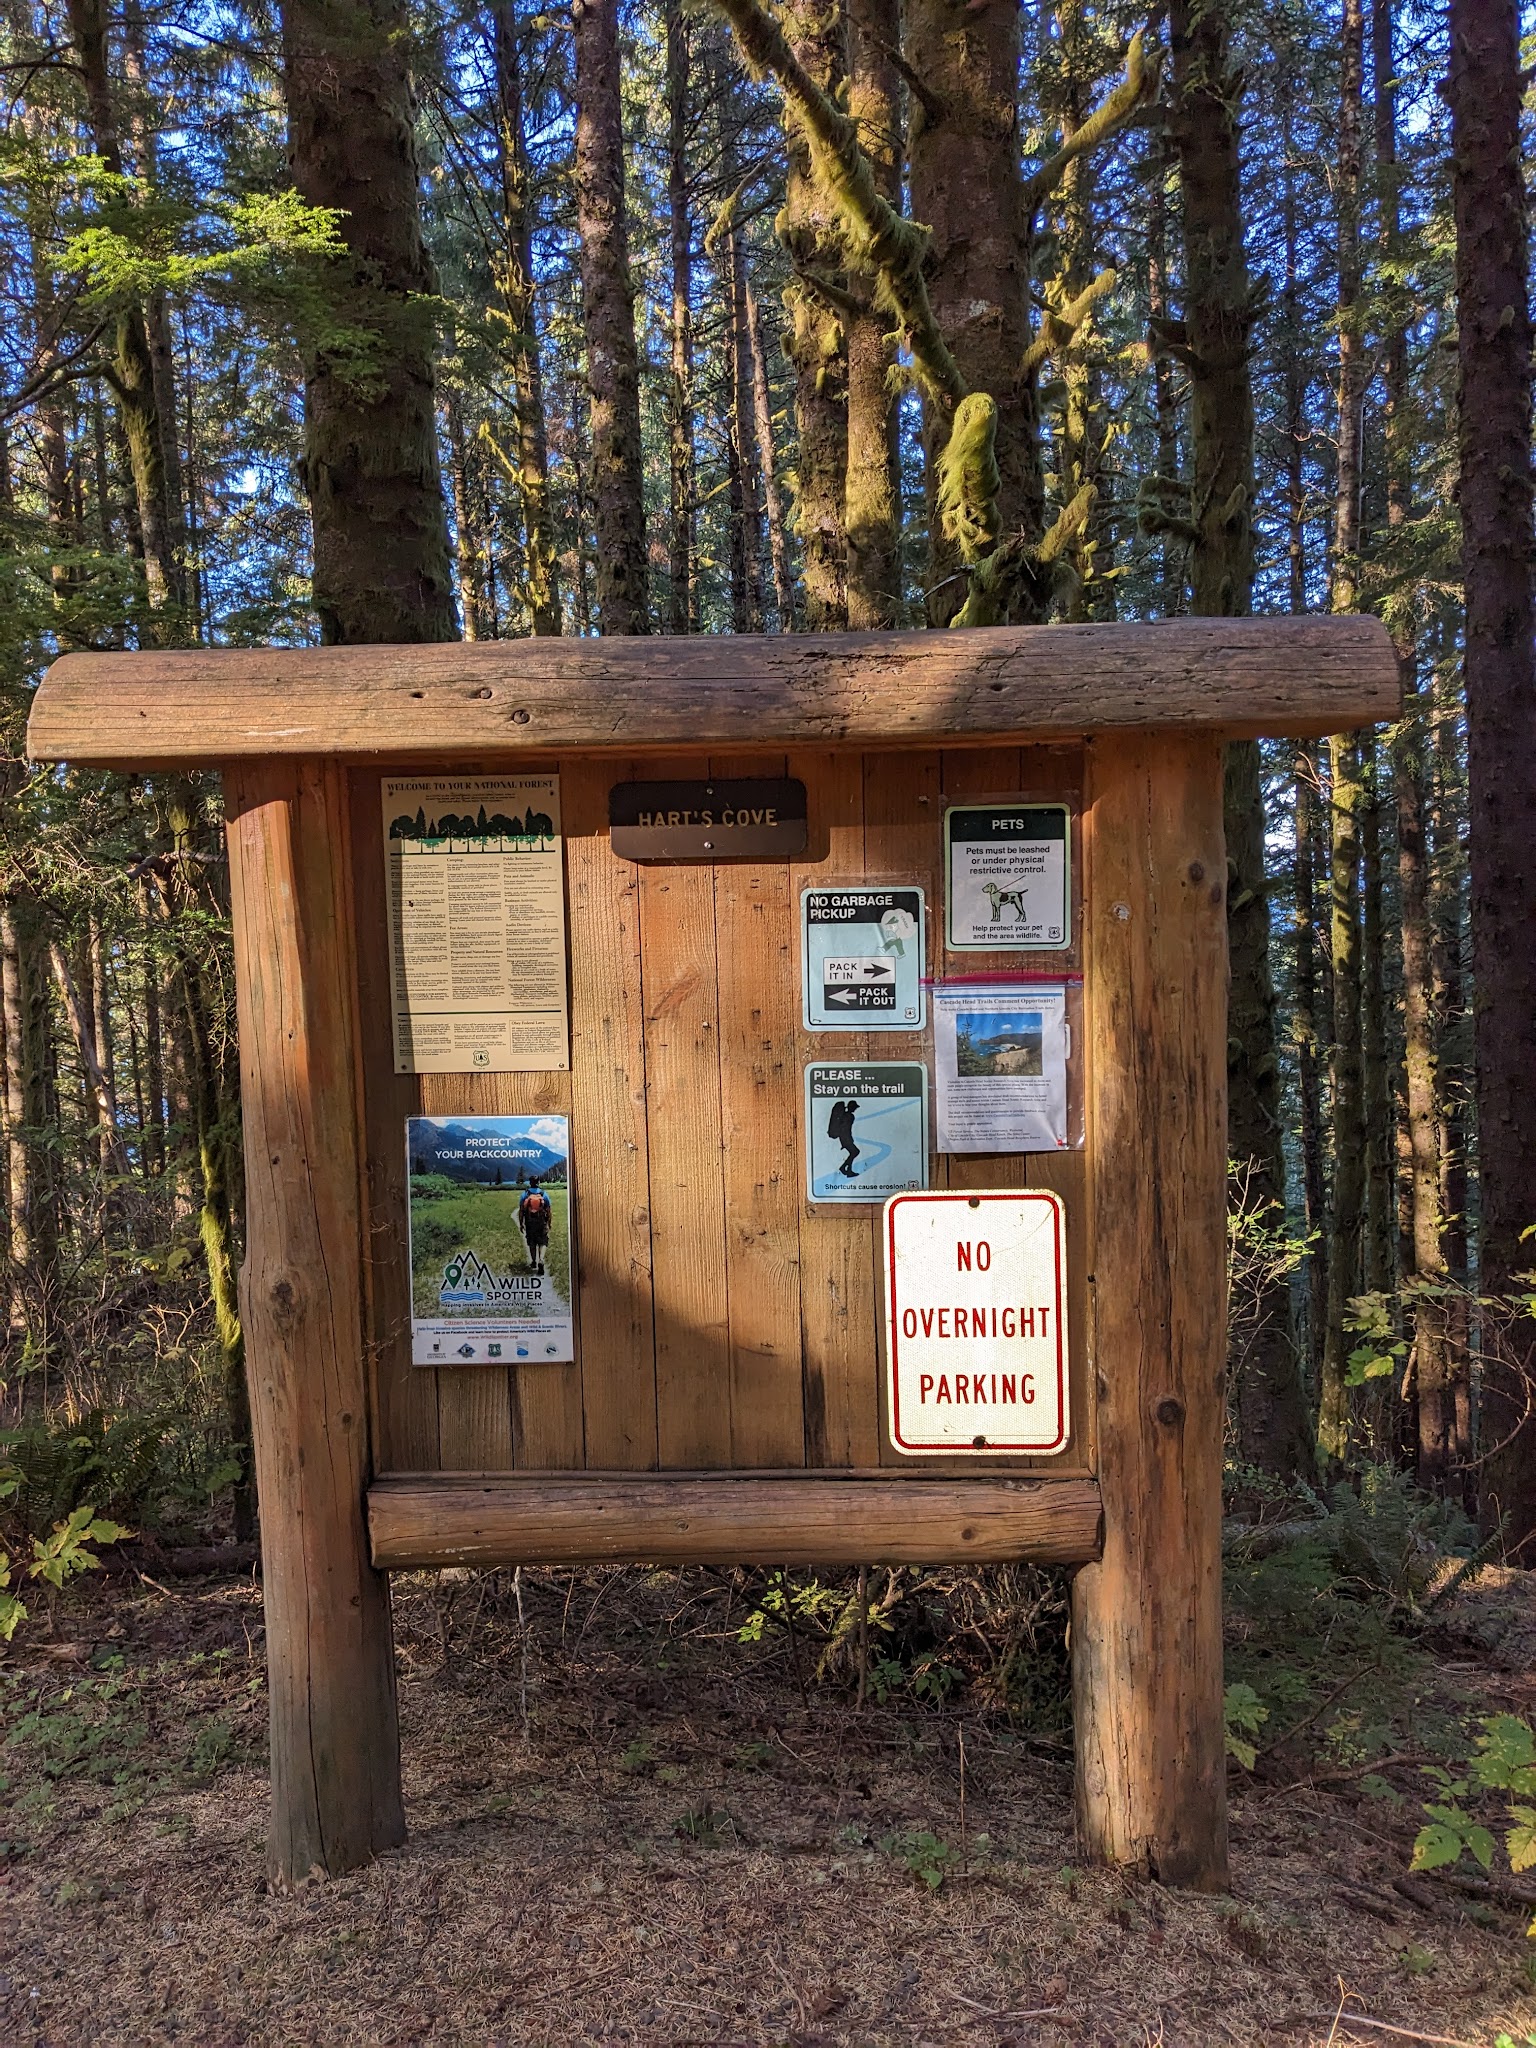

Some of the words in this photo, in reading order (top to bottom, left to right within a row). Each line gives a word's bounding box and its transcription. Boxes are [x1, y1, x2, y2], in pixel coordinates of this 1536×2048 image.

[387, 783, 431, 791] WELCOME
[474, 781, 517, 789] NATIONAL
[638, 810, 713, 829] HART'S
[722, 808, 778, 828] COVE
[992, 819, 1024, 830] PETS
[982, 856, 1007, 864] under
[1010, 856, 1044, 866] physical
[970, 866, 1012, 875] restrictive
[810, 896, 828, 907] NO
[831, 896, 893, 906] GARBAGE
[810, 908, 856, 920] PICKUP
[860, 988, 888, 996] PACK
[859, 997, 871, 1006] IT
[873, 996, 895, 1005] OUT
[814, 1070, 861, 1080] PLEASE
[814, 1084, 841, 1096] Stay
[843, 1086, 858, 1094] on
[860, 1084, 879, 1094] the
[882, 1084, 904, 1094] trail
[465, 1138, 512, 1146] PROTECT
[435, 1150, 464, 1159] YOUR
[466, 1150, 542, 1158] BACKCOUNTRY
[957, 1241, 992, 1272] NO
[498, 1278, 542, 1289] WILD
[486, 1291, 542, 1300] SPOTTER
[902, 1307, 1050, 1338] OVERNIGHT
[920, 1373, 1035, 1404] PARKING
